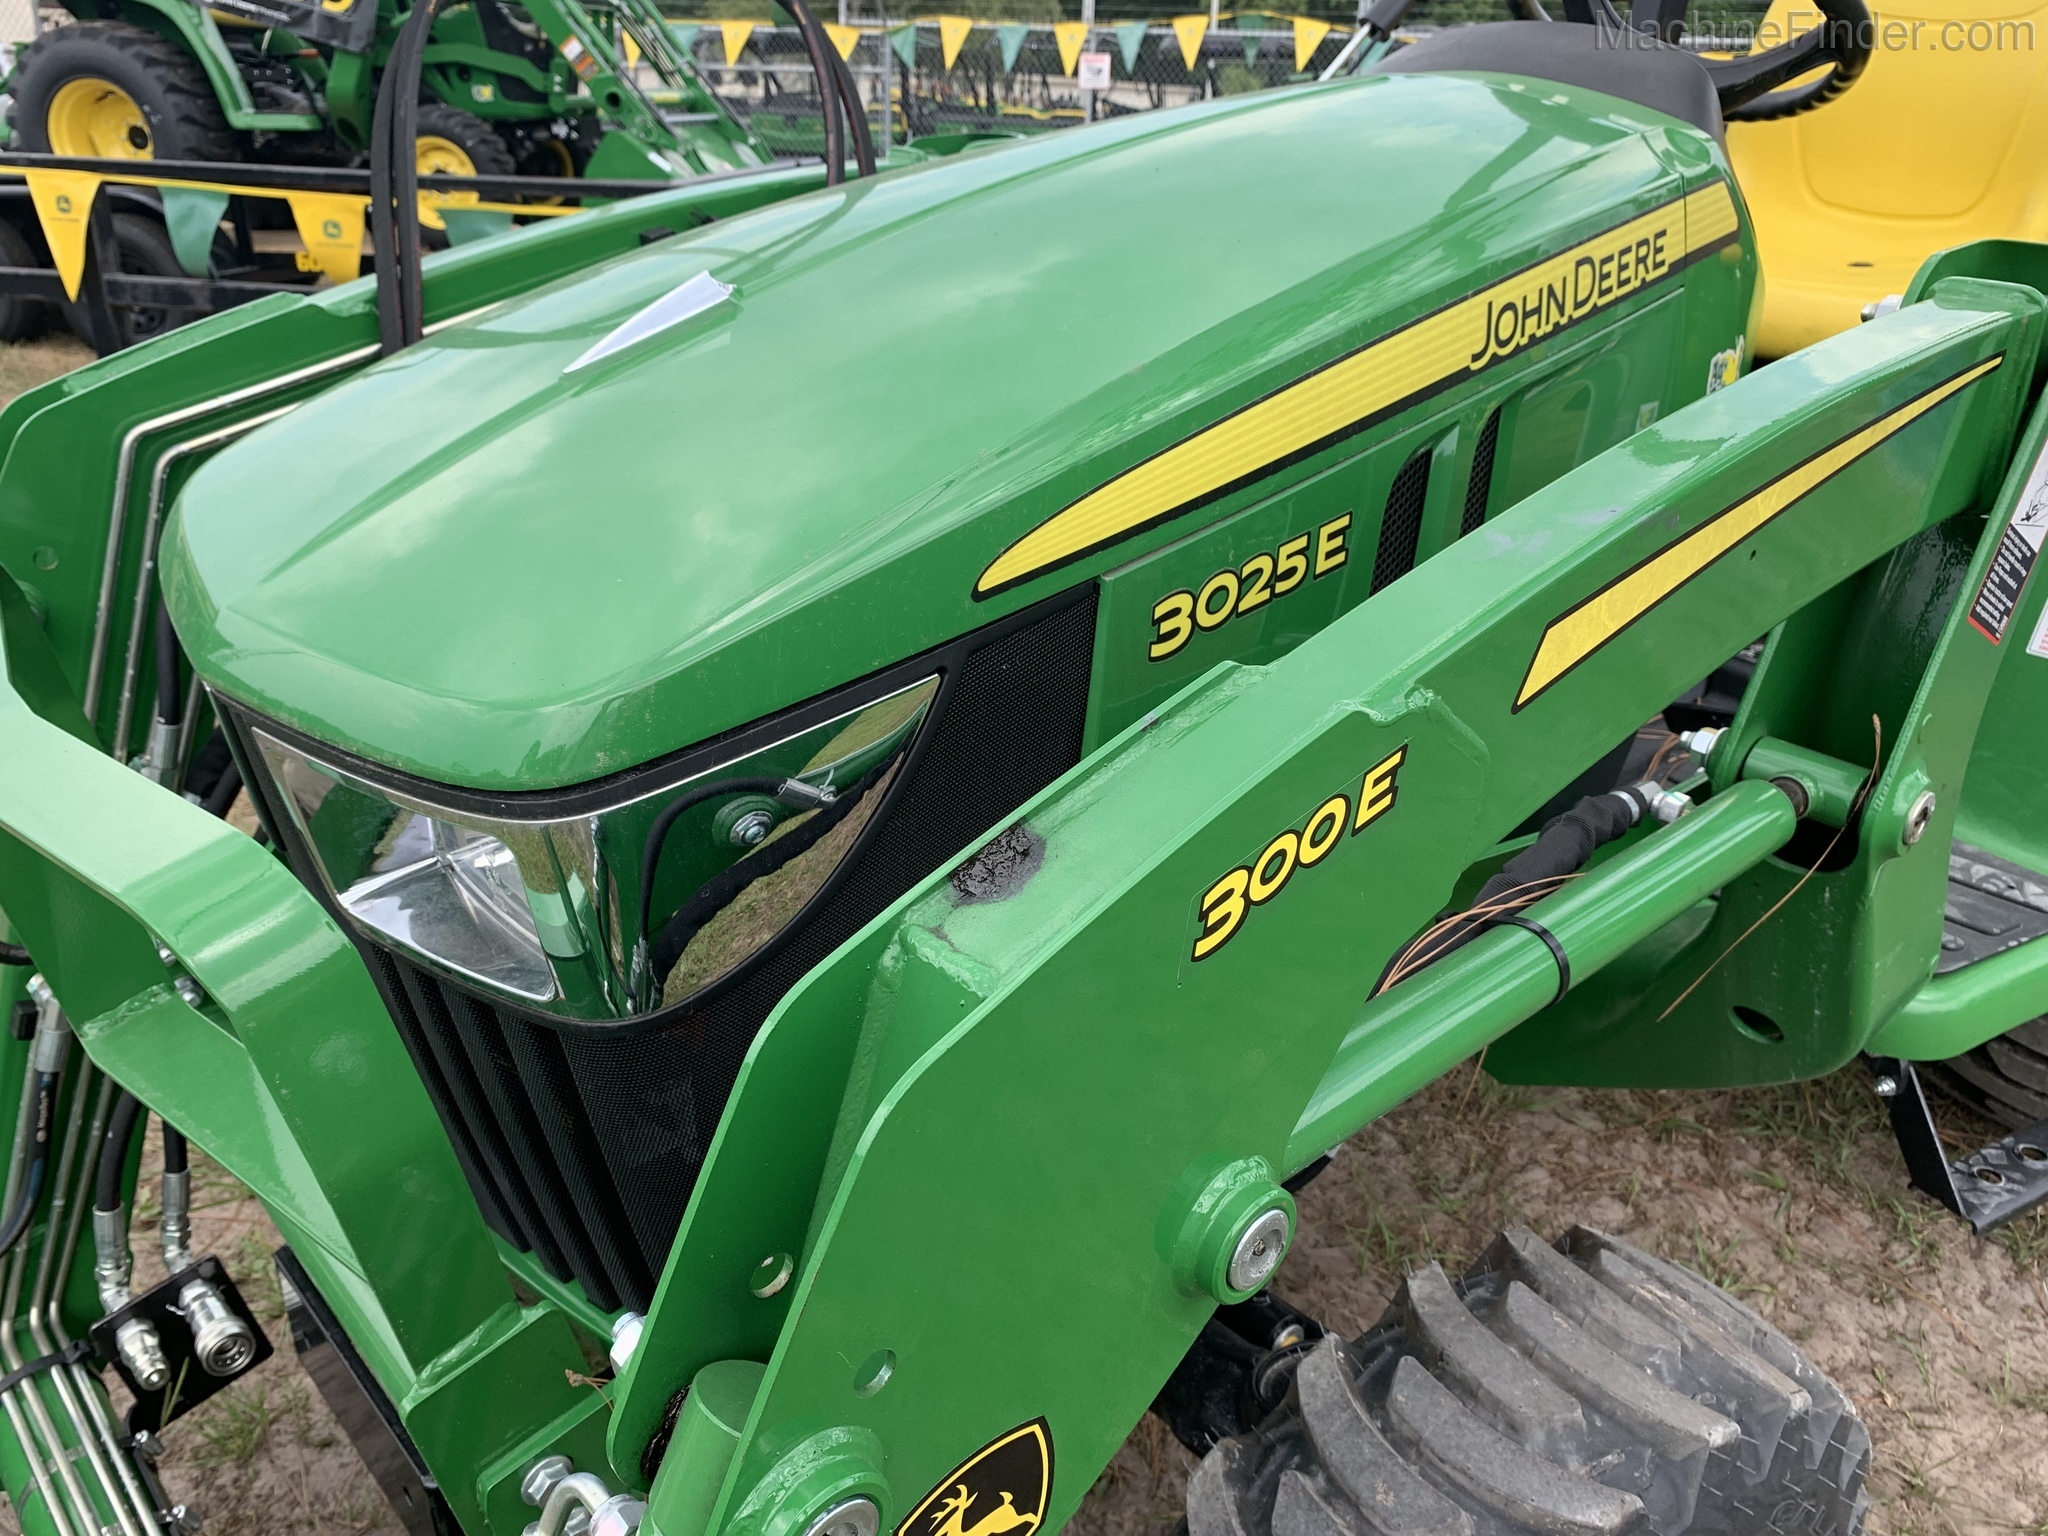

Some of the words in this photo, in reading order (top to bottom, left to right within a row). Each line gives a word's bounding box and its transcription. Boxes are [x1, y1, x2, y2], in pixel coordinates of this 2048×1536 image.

[1471, 276, 1567, 364] JOHN
[1573, 228, 1667, 311] DEERE
[1148, 510, 1353, 662] 3025E
